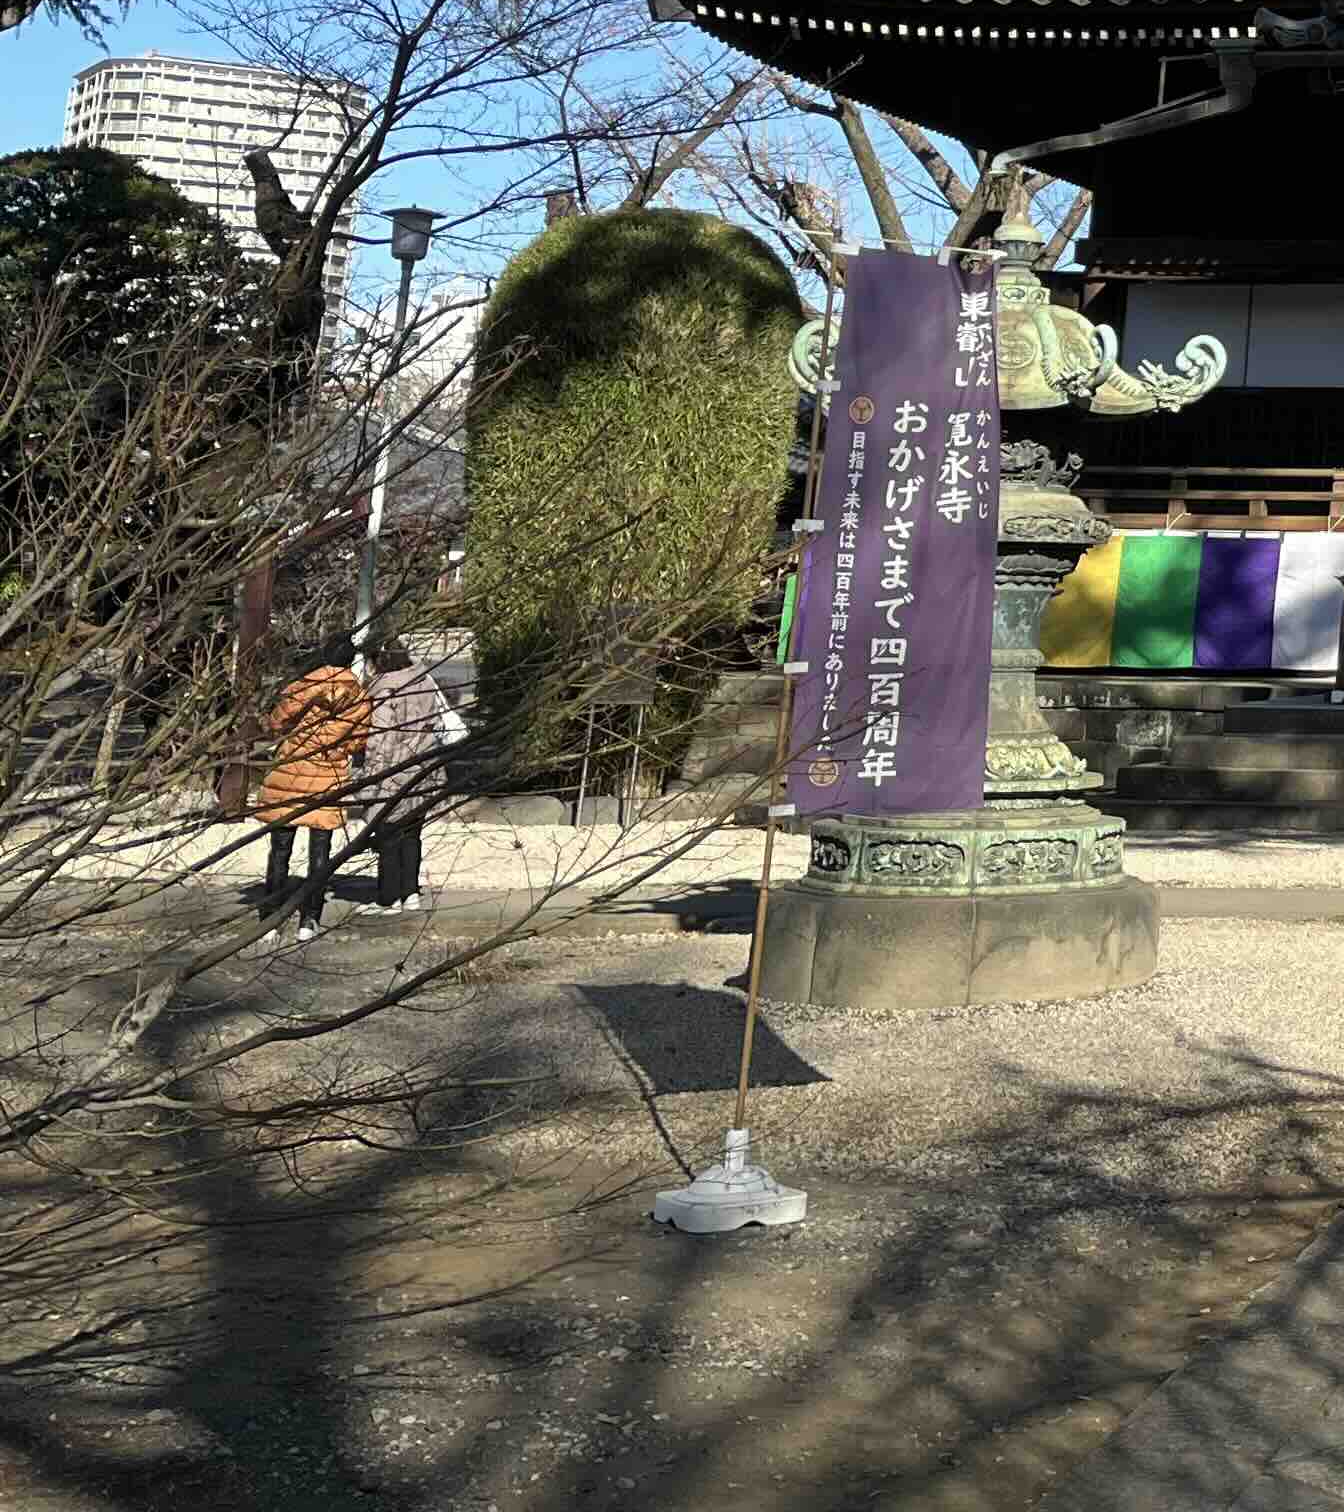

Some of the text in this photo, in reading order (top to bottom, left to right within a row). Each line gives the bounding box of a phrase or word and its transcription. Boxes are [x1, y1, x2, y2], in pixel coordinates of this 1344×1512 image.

[976, 410, 992, 519] かんえいじ
[857, 400, 928, 787] おかげさまで四百周年
